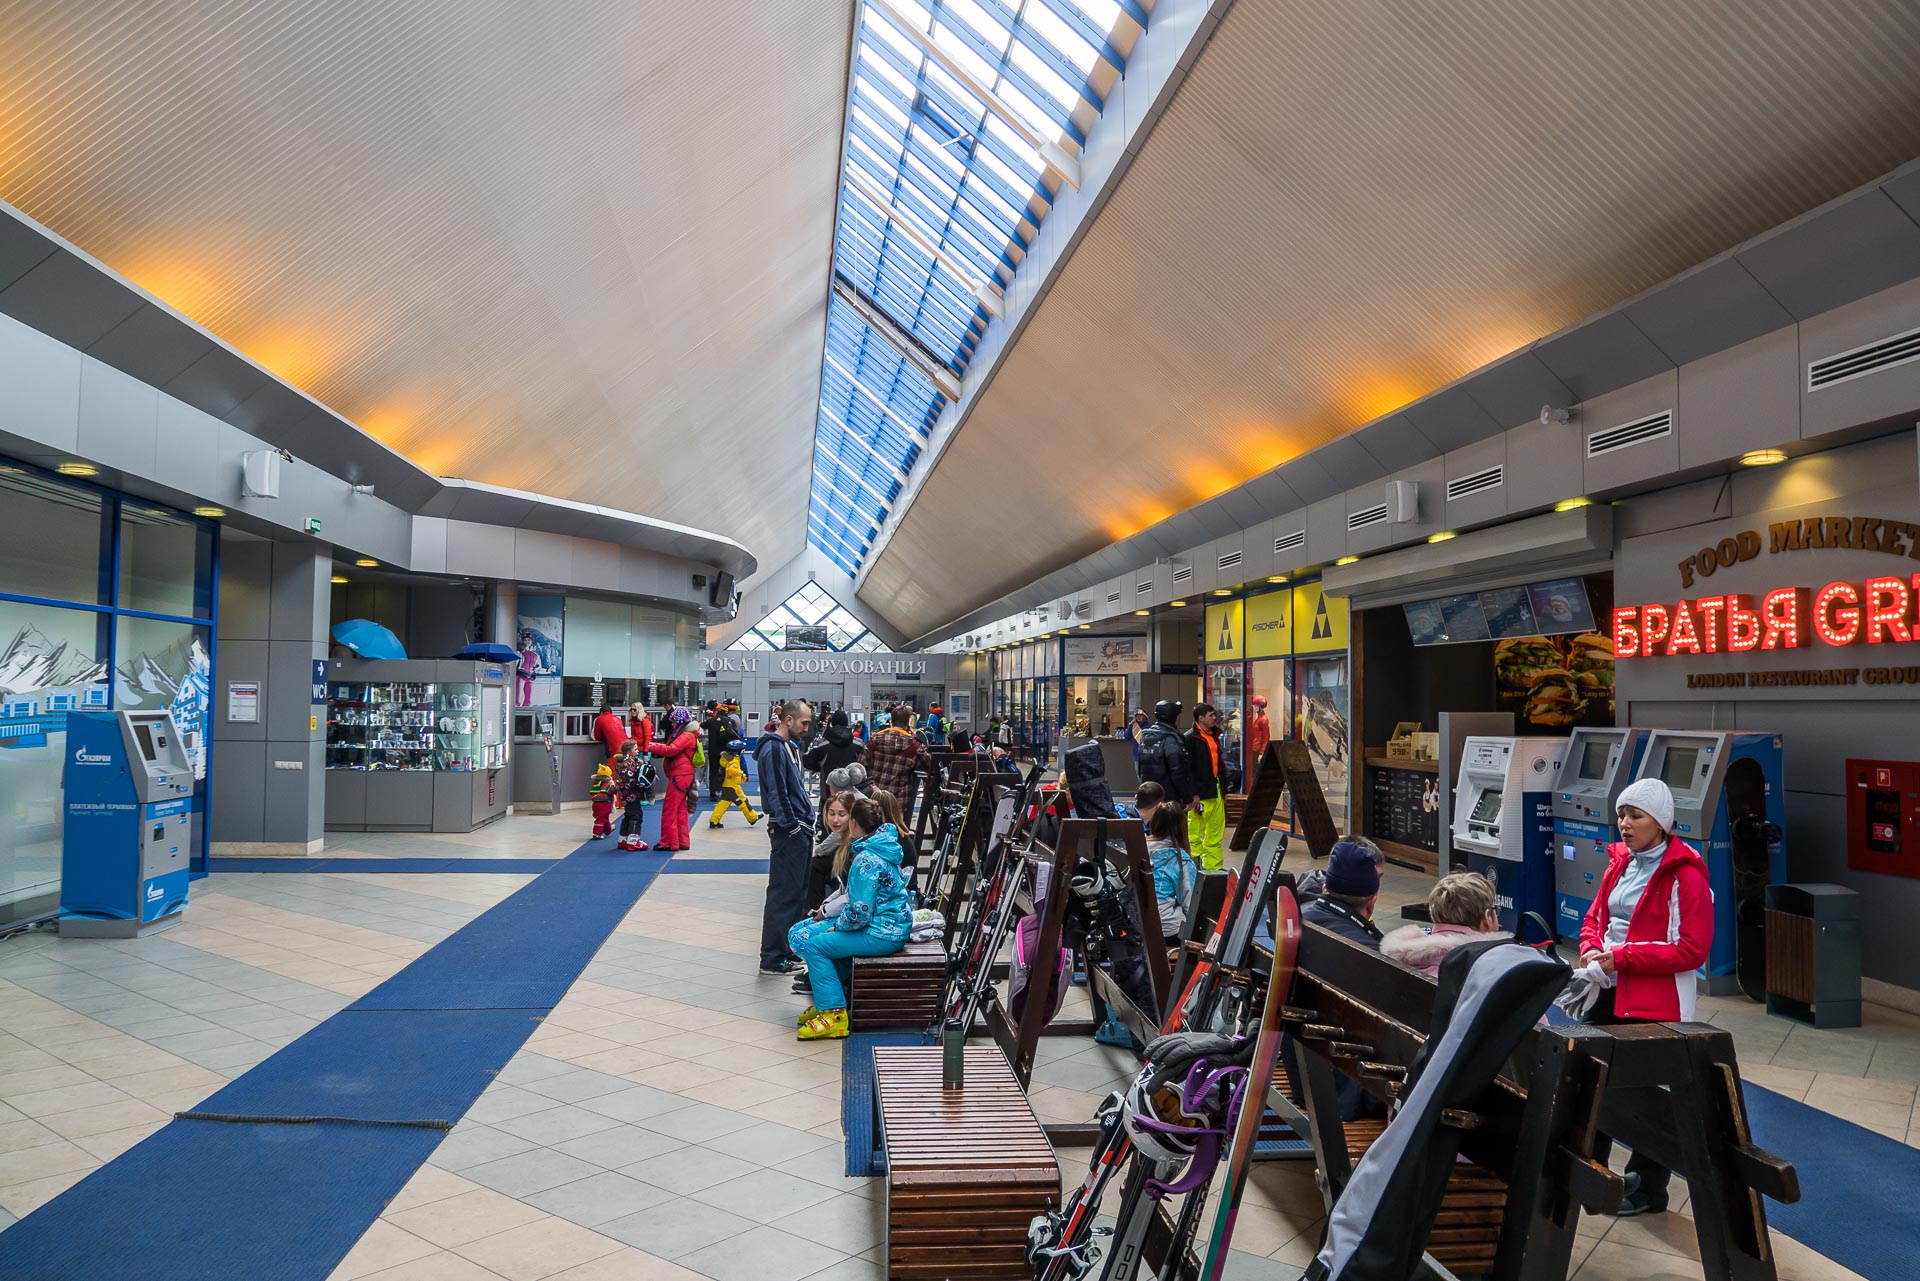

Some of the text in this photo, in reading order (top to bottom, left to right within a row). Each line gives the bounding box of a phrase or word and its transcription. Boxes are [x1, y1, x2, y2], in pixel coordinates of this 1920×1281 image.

[1679, 530, 1762, 588] FOOD
[1251, 621, 1279, 632] FISCHER
[1612, 587, 1800, 659] БРАТЬЯ
[780, 658, 927, 674] ОБОРУДОВАНИЯ
[1687, 672, 1746, 689] LONDON
[1747, 668, 1859, 688] RESTAURANT
